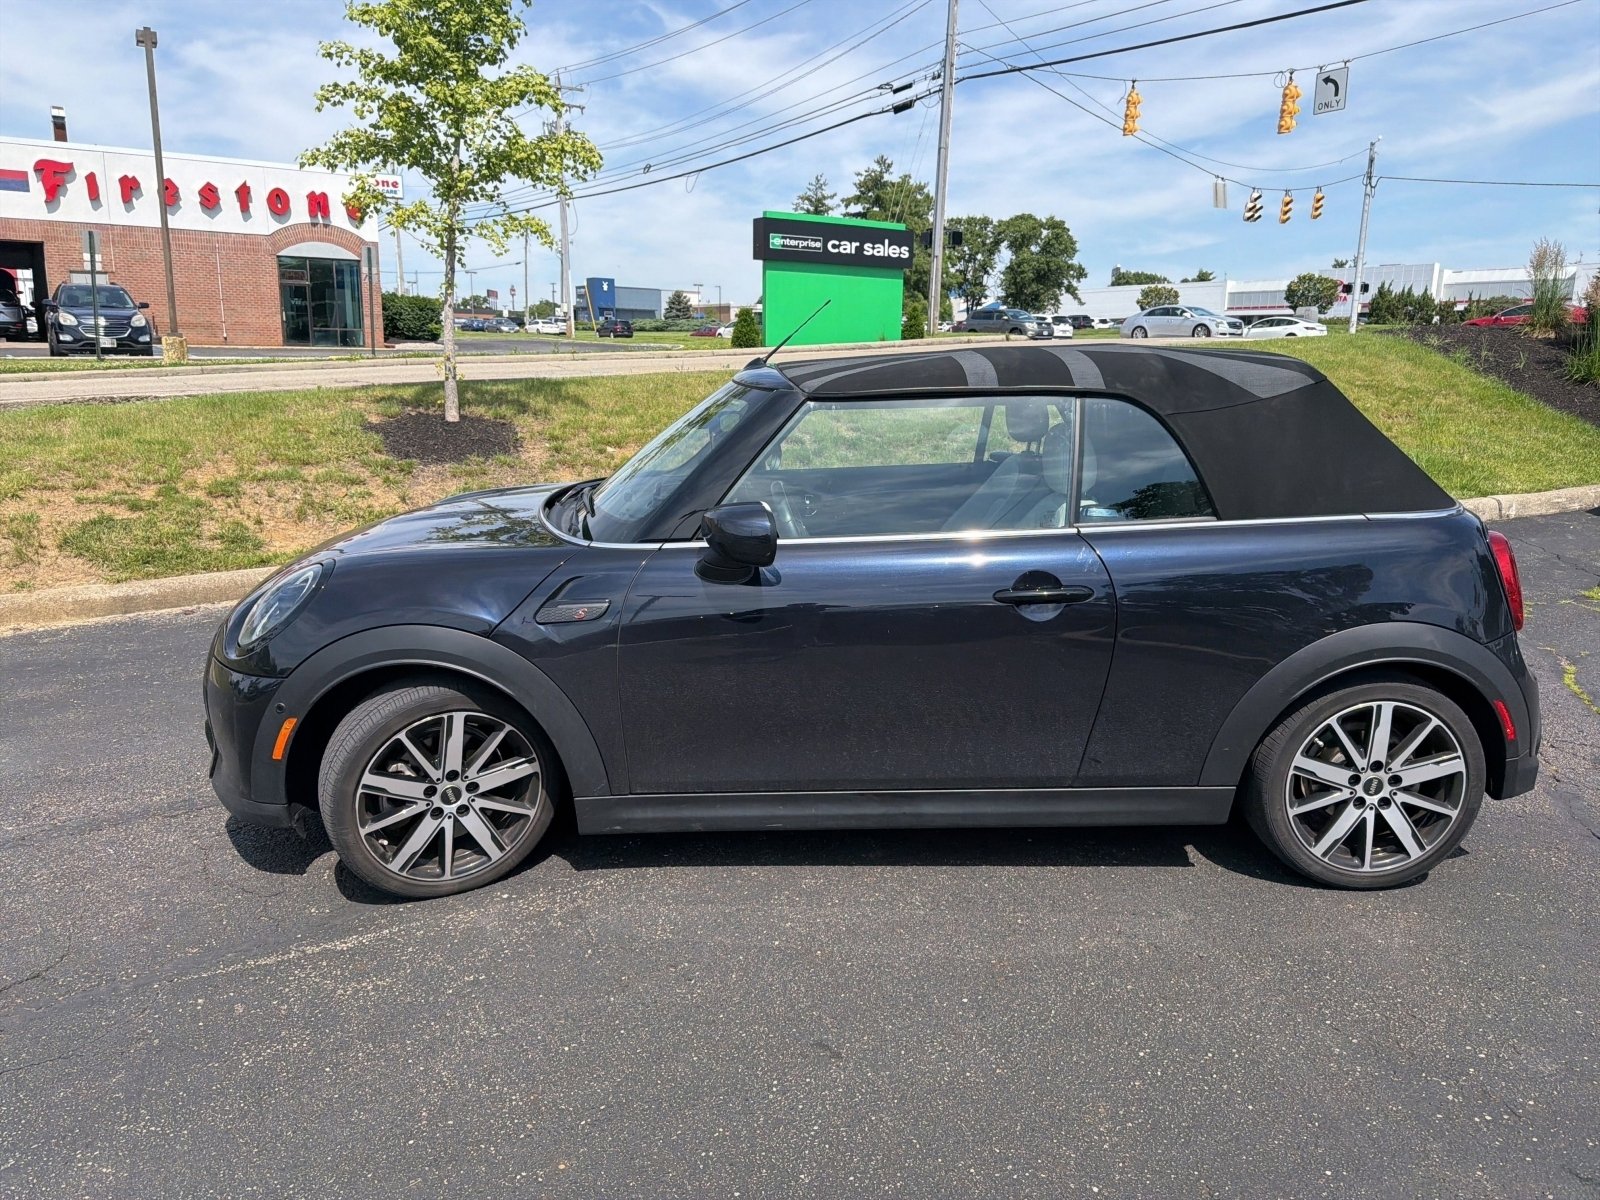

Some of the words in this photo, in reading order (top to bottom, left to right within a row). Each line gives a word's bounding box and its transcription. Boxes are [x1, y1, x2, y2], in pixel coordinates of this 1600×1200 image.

[1317, 98, 1341, 111] ONLY
[771, 237, 822, 248] enterprise
[827, 239, 860, 255] car
[863, 239, 910, 259] sales
